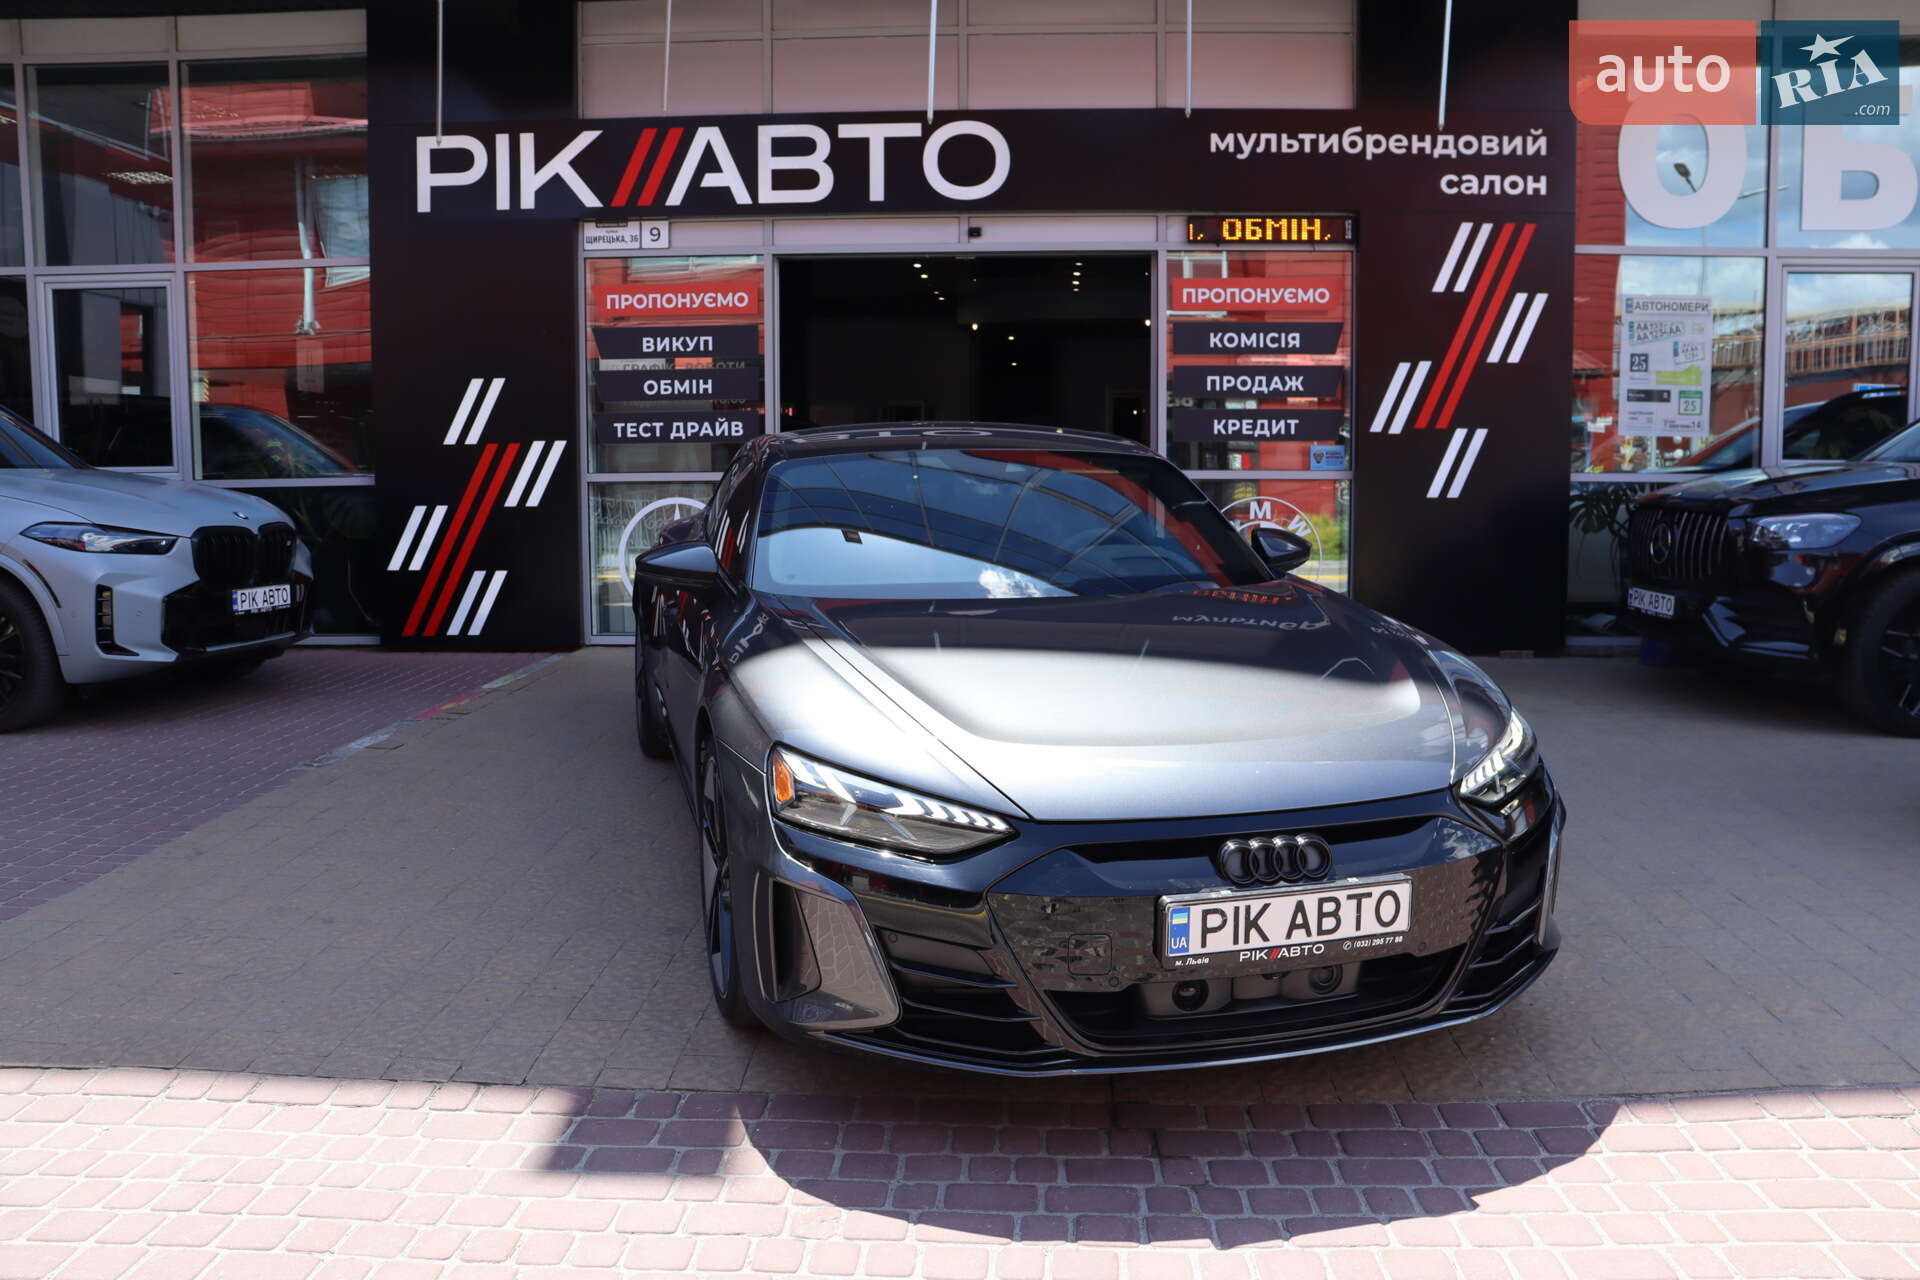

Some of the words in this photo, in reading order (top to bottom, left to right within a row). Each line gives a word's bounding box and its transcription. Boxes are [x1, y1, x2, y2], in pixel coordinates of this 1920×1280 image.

[1209, 126, 1548, 160] мультибрендовий
[1439, 172, 1548, 196] салон
[649, 226, 661, 242] 9
[606, 291, 749, 310] ПРОПОНУЄМО
[1182, 287, 1330, 304] ПРОПОНУЄМО
[1634, 301, 1709, 313] АВТОНОМЕРИ
[642, 336, 713, 353] ВИКУП
[1209, 332, 1301, 348] КОМІСІЯ
[1631, 356, 1647, 371] 25
[643, 379, 713, 396] ОБМІН
[1206, 375, 1305, 394] ПРОДАЖ
[613, 422, 665, 438] ТЕСТ
[669, 417, 744, 440] ДРАЙВ
[1213, 418, 1300, 437] КРЕДИТ
[1171, 936, 1188, 950] UA
